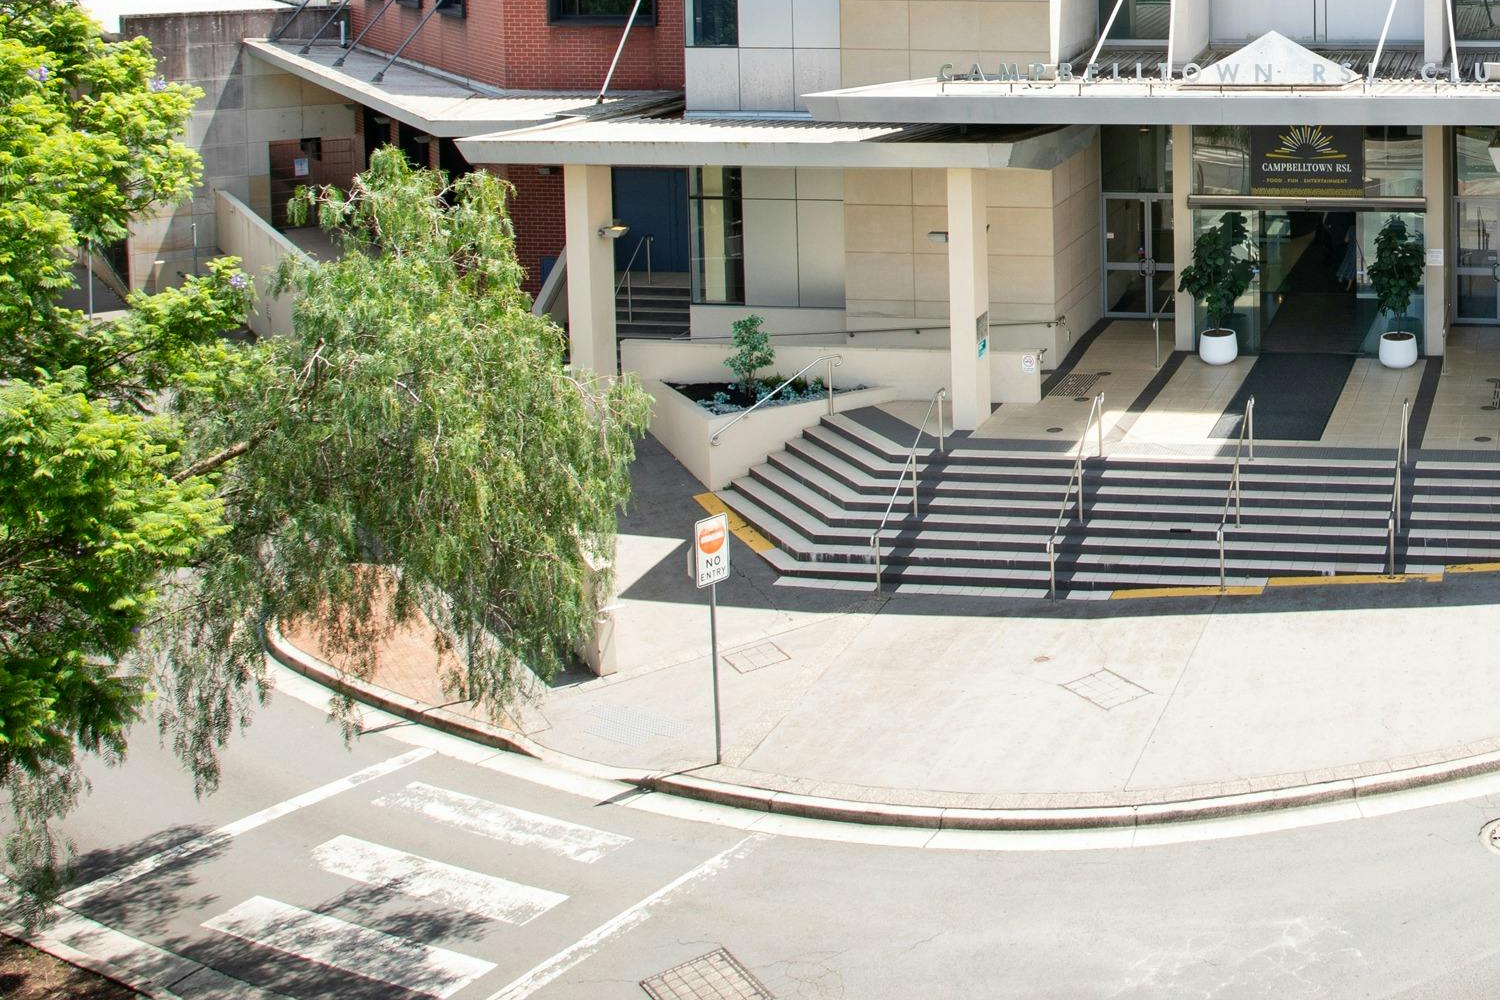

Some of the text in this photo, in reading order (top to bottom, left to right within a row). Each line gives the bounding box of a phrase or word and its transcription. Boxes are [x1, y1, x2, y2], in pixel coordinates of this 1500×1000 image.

[938, 63, 1272, 83] CAMPBELLTOWN
[1313, 62, 1378, 83] RSL
[1261, 162, 1352, 172] CAMPBELLTOWN RSL
[705, 555, 721, 569] NO
[700, 566, 726, 582] ENTRY
